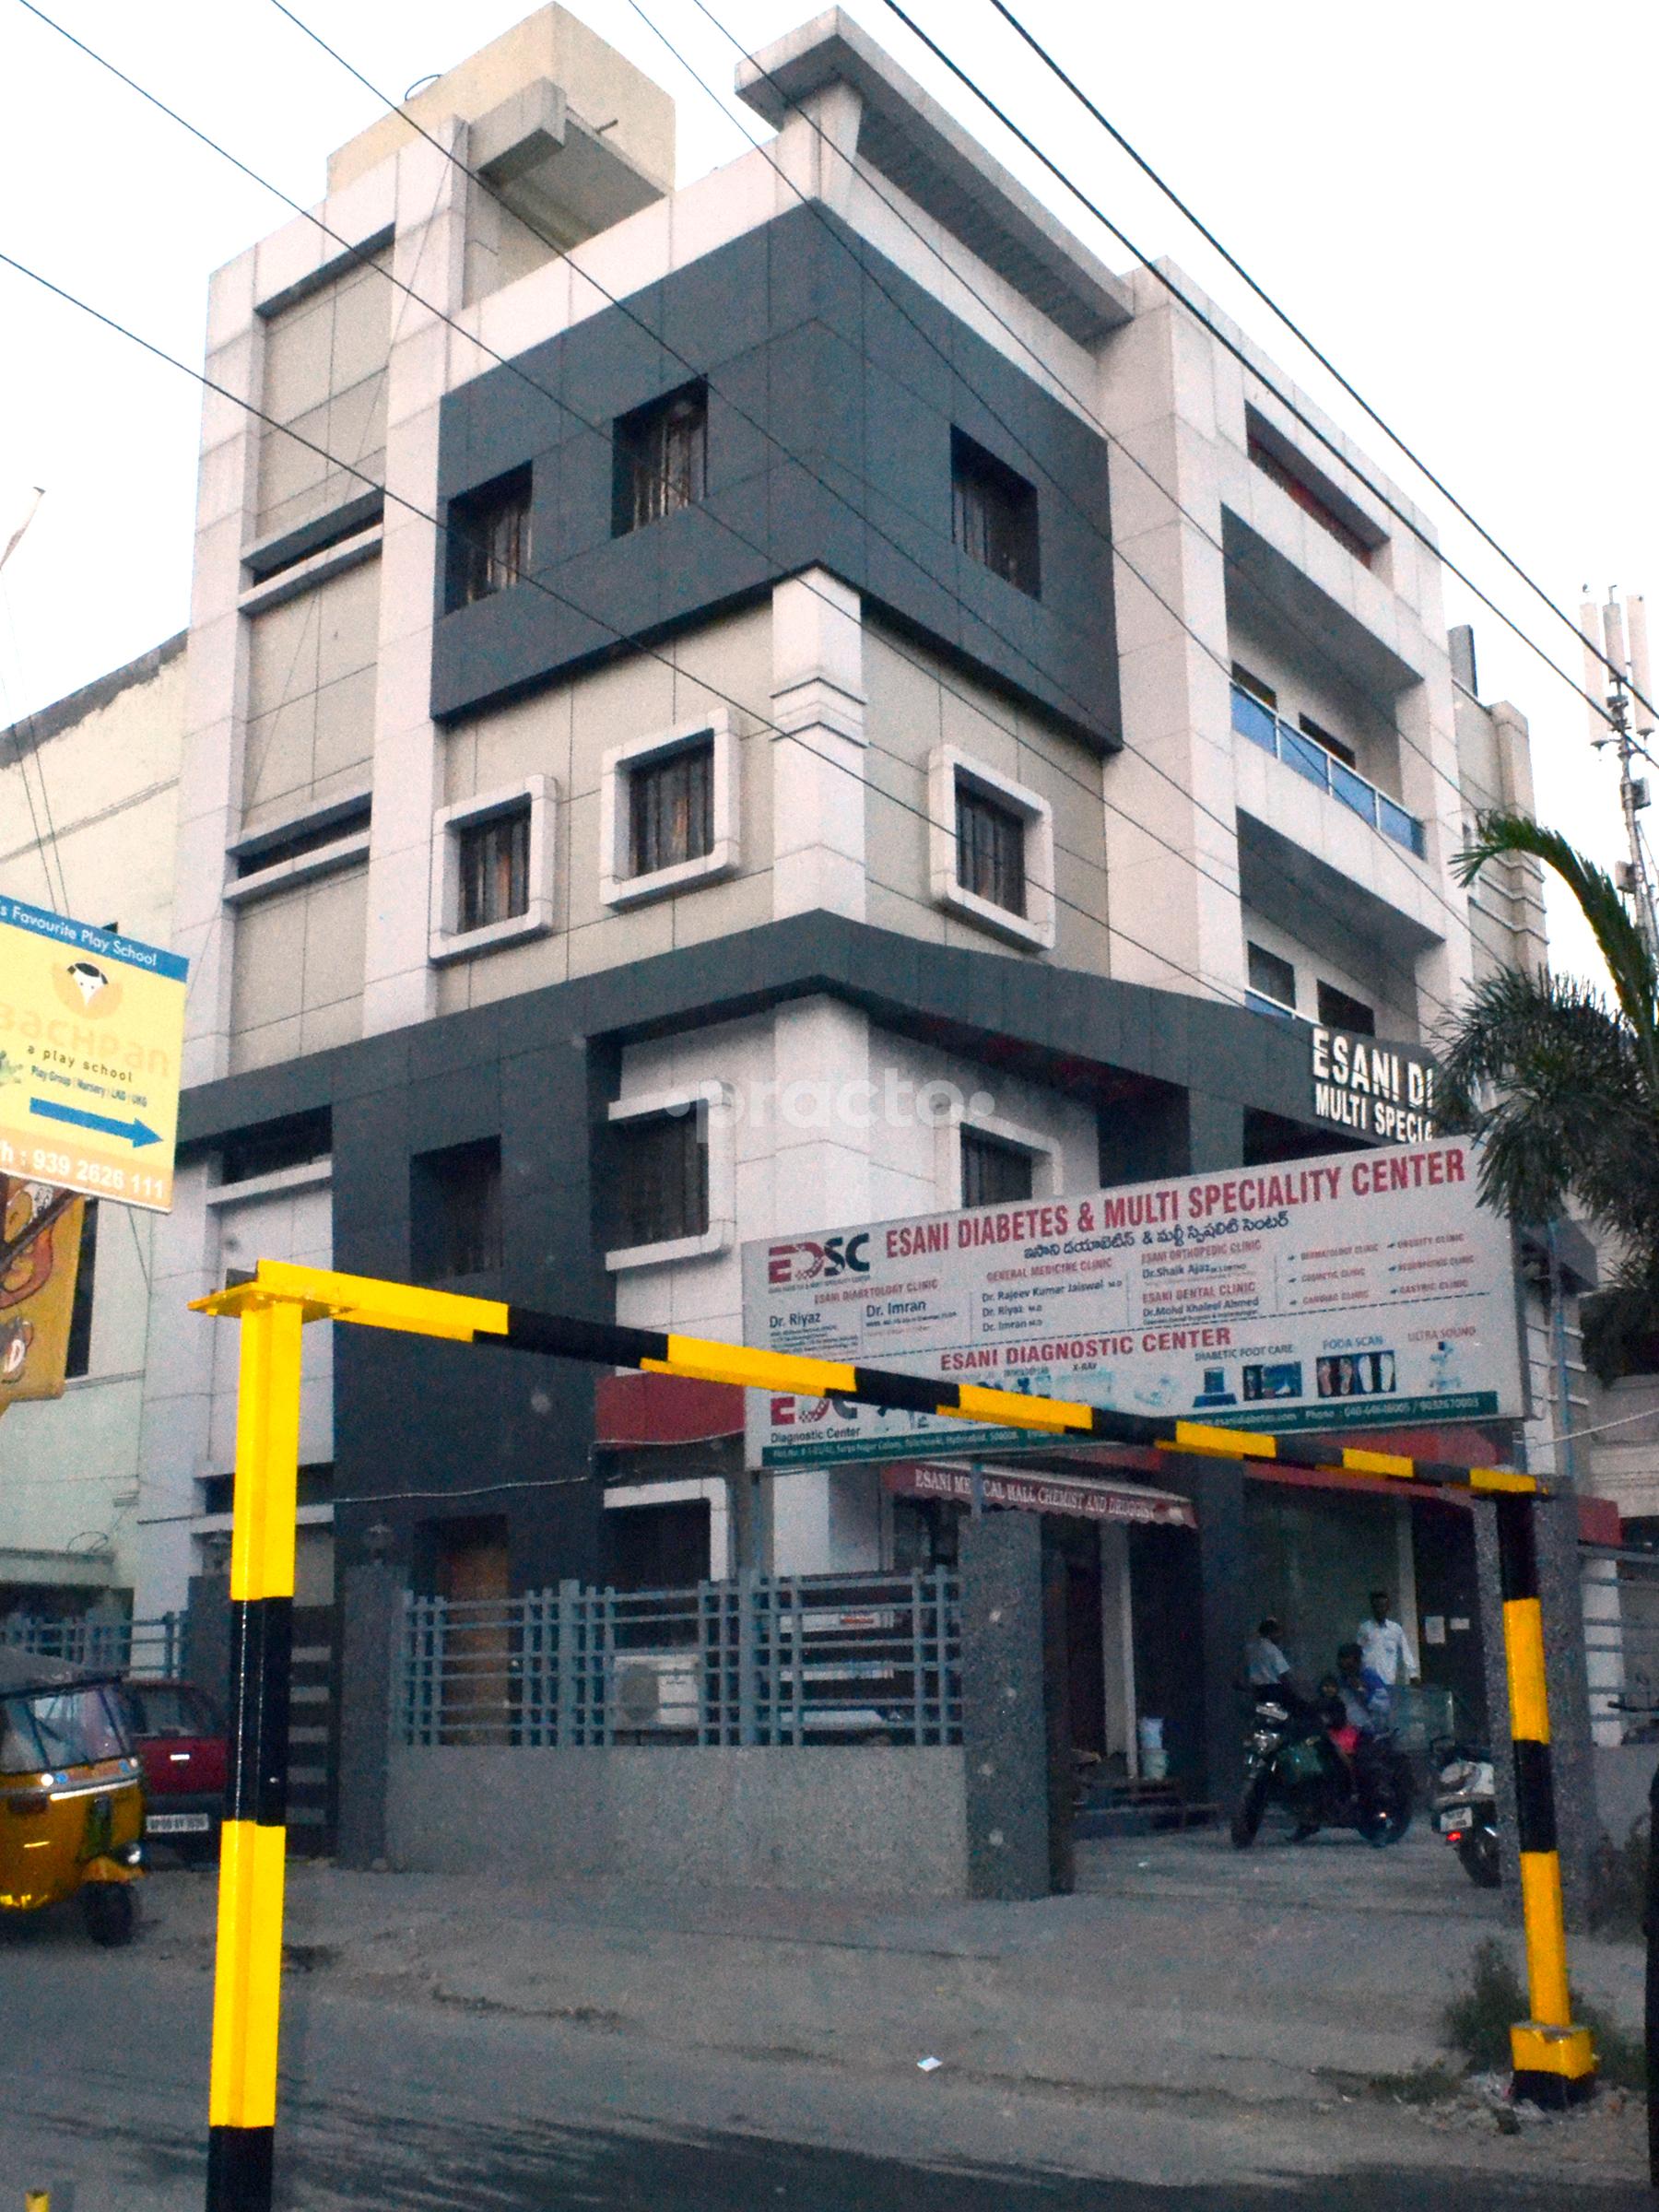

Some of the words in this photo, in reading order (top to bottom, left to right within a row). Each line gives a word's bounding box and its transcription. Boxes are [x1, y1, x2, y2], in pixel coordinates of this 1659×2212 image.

[12, 905, 76, 939] Favourite
[81, 930, 110, 953] Play
[113, 940, 158, 966] School
[26, 1044, 35, 1054] a
[41, 1050, 76, 1068] play
[82, 1060, 133, 1083] school
[1312, 1027, 1399, 1101] ESANI
[1315, 1083, 1366, 1130] MULTI
[32, 1149, 71, 1176] 939
[76, 1160, 124, 1190] 2626
[131, 1173, 163, 1199] 111
[886, 1221, 948, 1259] ESANI
[958, 1205, 1069, 1249] DIABETES
[1077, 1202, 1095, 1233] &
[1104, 1190, 1179, 1230] MULTI
[1188, 1167, 1342, 1218] SPECIALITY
[1352, 1148, 1465, 1196] CENTER
[768, 1232, 871, 1284] EDSC
[907, 1279, 938, 1292] CLINIC
[789, 1312, 821, 1326] Riyaz
[865, 1304, 884, 1318] Dr.
[888, 1300, 927, 1315] Imran
[941, 1349, 998, 1371] ESANI
[1006, 1335, 1134, 1364] DIAGNOSTIC
[1142, 1327, 1231, 1355] CENTER
[1268, 1344, 1294, 1355] CARE
[771, 1429, 824, 1445] Diagnostic
[827, 1427, 861, 1440] Center
[915, 1468, 951, 1491] ESANI
[953, 1474, 1005, 1499] MECAL
[1006, 1482, 1036, 1503] HALL
[1037, 1485, 1084, 1510] CHEMIST
[1085, 1493, 1107, 1513] AND
